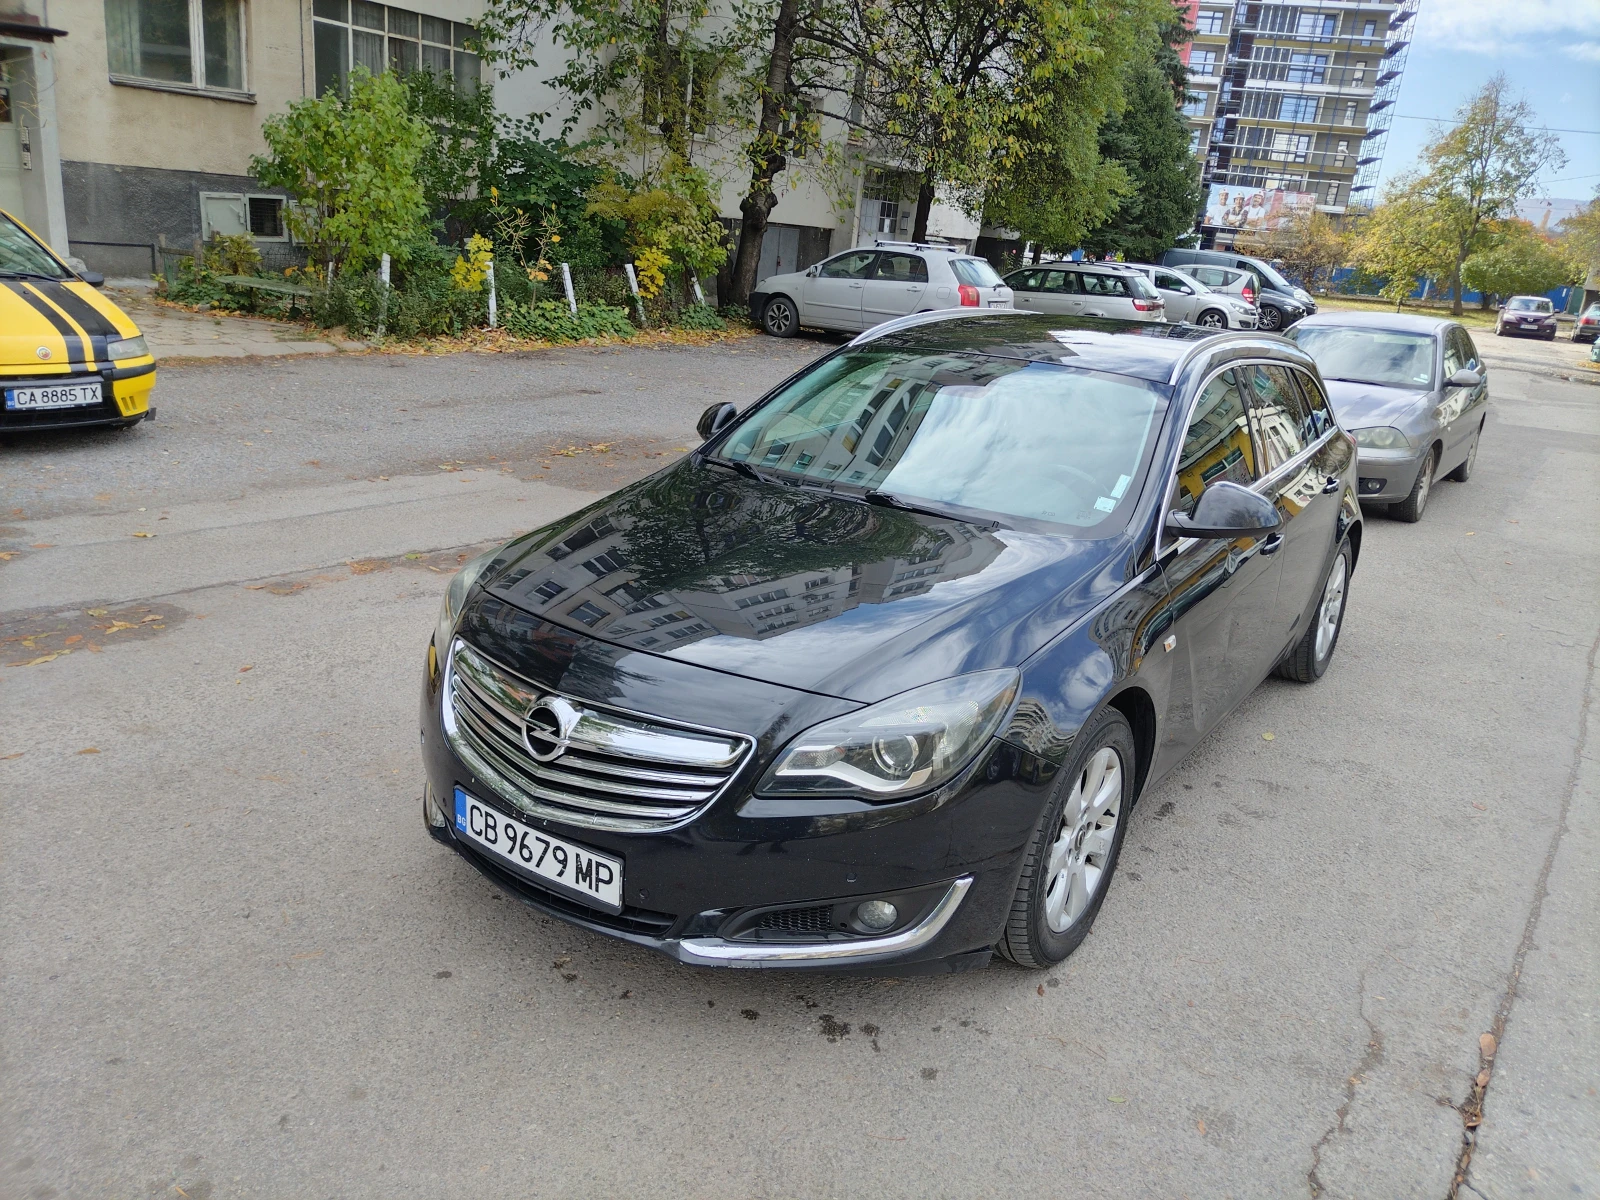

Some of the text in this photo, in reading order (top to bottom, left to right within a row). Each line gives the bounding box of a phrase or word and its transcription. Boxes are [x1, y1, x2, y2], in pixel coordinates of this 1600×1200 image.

[17, 386, 98, 405] CA 8885 TX
[457, 813, 466, 827] BG
[470, 804, 614, 893] CB 9679 MP
